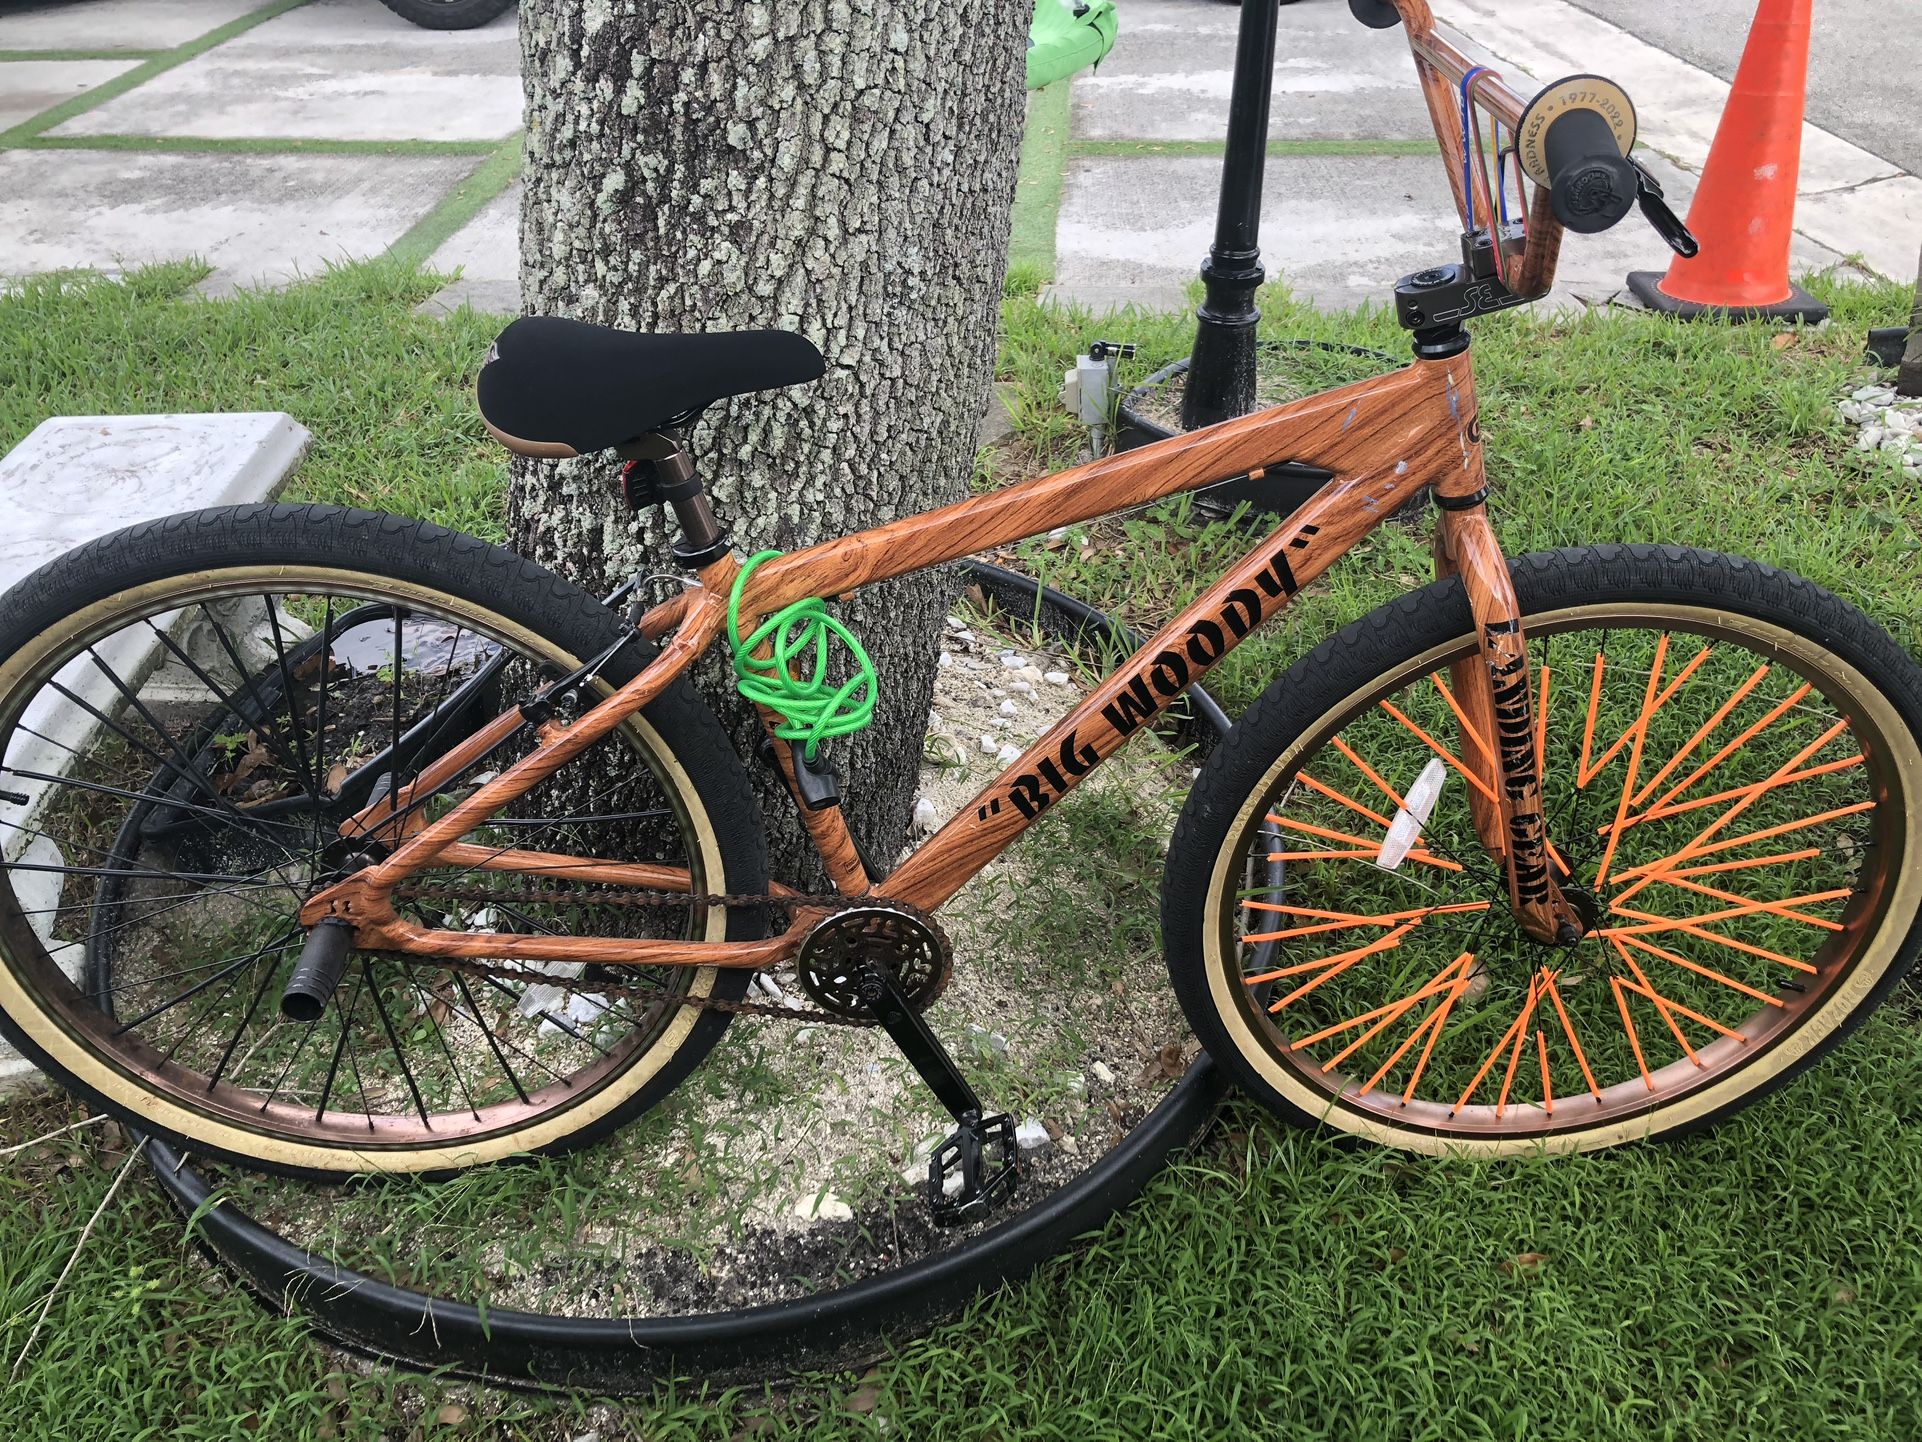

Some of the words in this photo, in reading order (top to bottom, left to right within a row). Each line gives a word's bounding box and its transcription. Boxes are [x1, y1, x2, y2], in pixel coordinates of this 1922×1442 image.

[1559, 91, 1624, 130] 1977-2022
[1459, 283, 1500, 317] SE
[1508, 812, 1549, 907] GEAR
